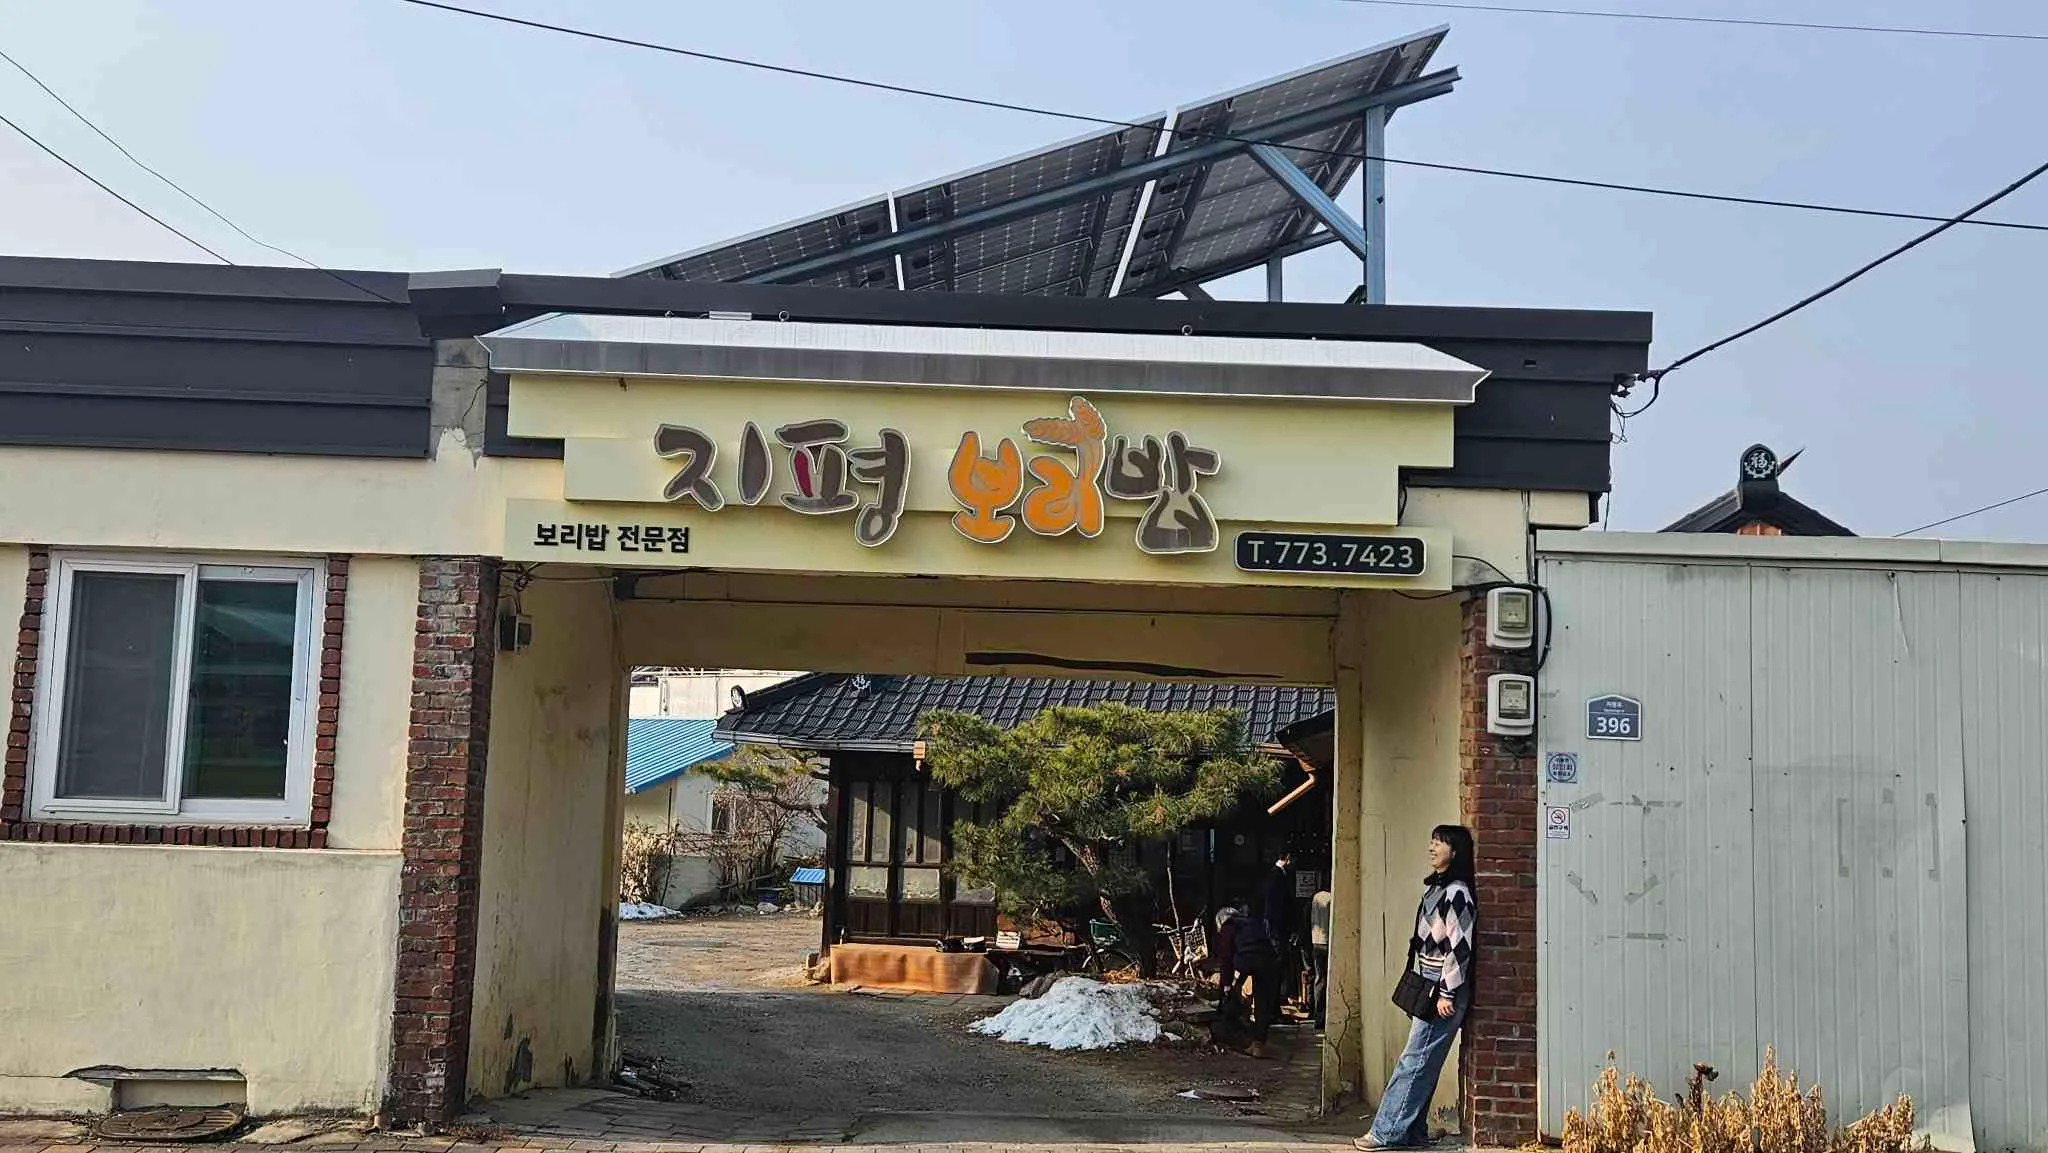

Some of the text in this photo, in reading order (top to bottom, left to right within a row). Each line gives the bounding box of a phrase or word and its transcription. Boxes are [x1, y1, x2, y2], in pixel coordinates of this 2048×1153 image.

[655, 396, 1221, 554] 지평 보리밥
[533, 523, 690, 553] 보리밥 전문점
[1247, 540, 1414, 569] T.773.7423
[1595, 716, 1631, 734] 396
